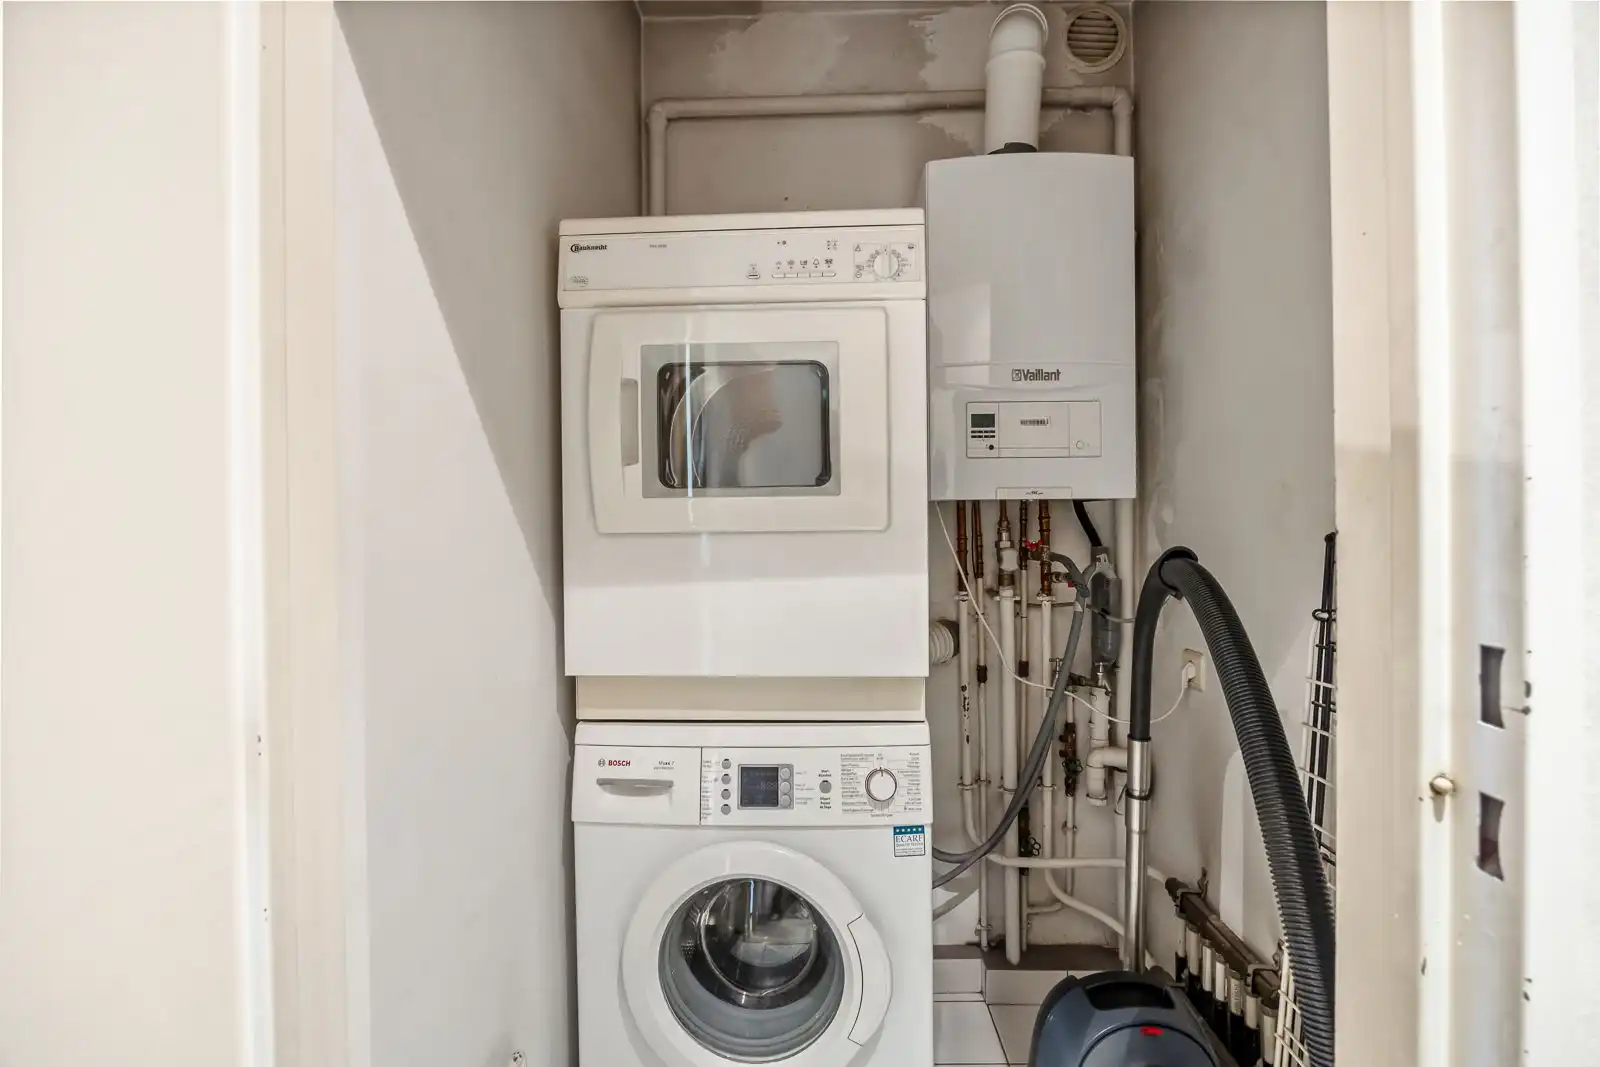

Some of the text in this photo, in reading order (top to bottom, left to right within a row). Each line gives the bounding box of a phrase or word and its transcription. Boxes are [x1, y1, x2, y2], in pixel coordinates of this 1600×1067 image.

[570, 243, 607, 253] Bauknecht
[1021, 368, 1062, 381] Vaillant
[608, 759, 631, 767] BOSCH
